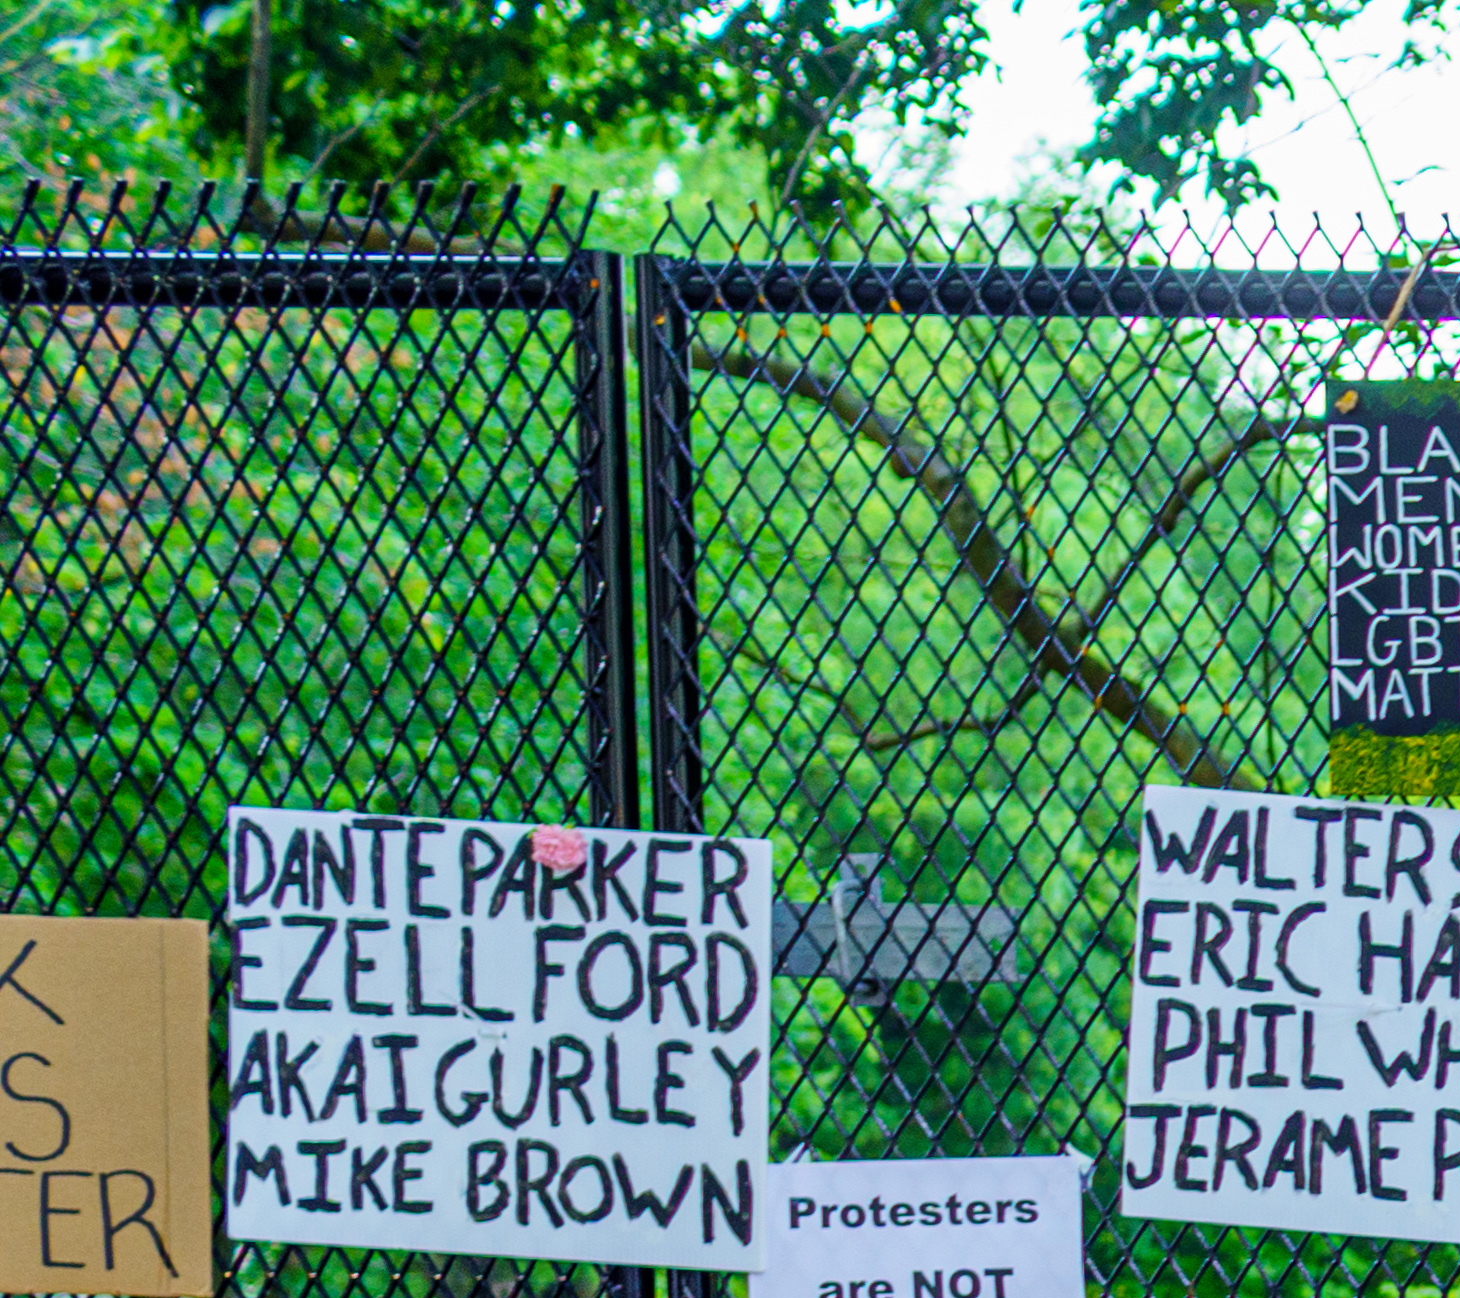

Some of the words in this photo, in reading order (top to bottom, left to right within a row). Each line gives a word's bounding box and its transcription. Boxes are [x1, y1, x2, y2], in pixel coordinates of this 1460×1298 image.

[1147, 806, 1432, 903] WALTER
[1141, 900, 1325, 995] ERIC
[1153, 999, 1344, 1091] PHIL
[1127, 1105, 1412, 1200] JERAME
